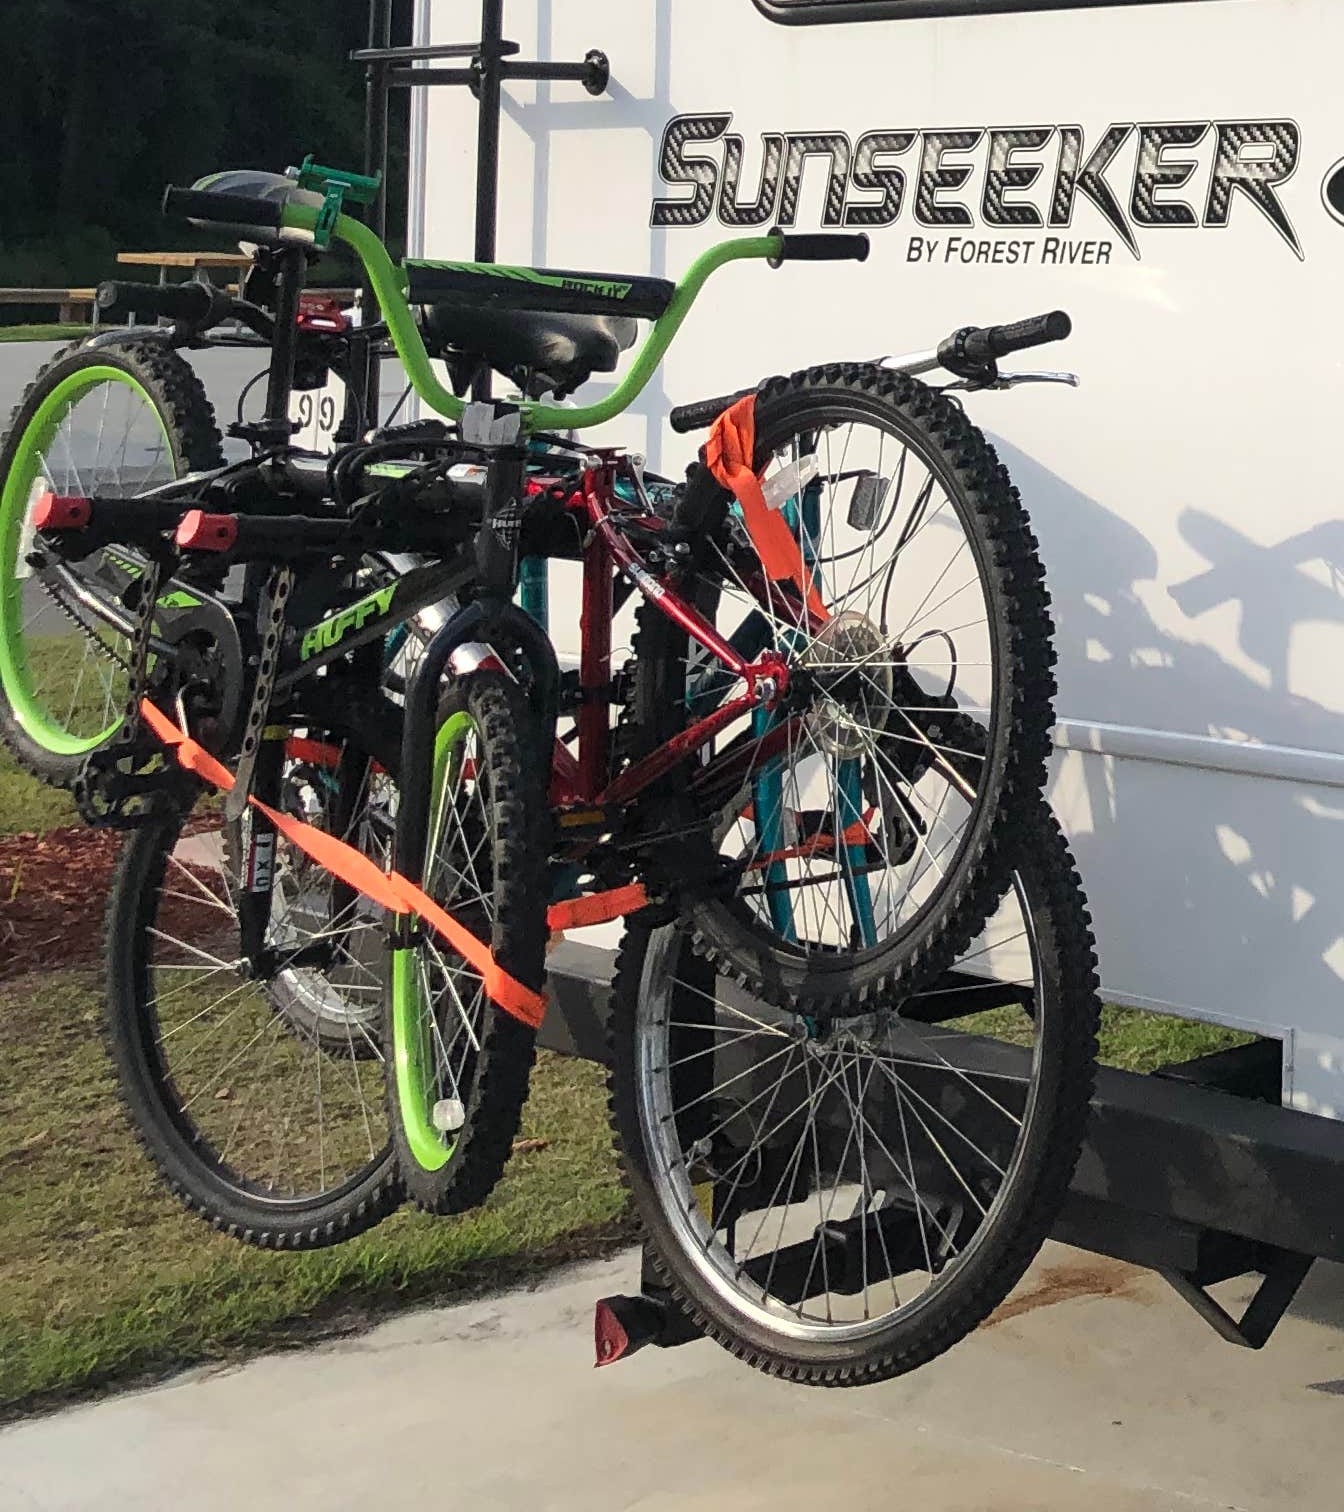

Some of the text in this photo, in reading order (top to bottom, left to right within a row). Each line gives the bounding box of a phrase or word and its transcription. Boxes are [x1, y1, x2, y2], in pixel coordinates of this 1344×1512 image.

[649, 112, 1305, 263] SUNSEEKER
[944, 236, 1036, 264] FOREST
[1041, 238, 1112, 265] RIVER
[300, 579, 399, 661] HUFFY
